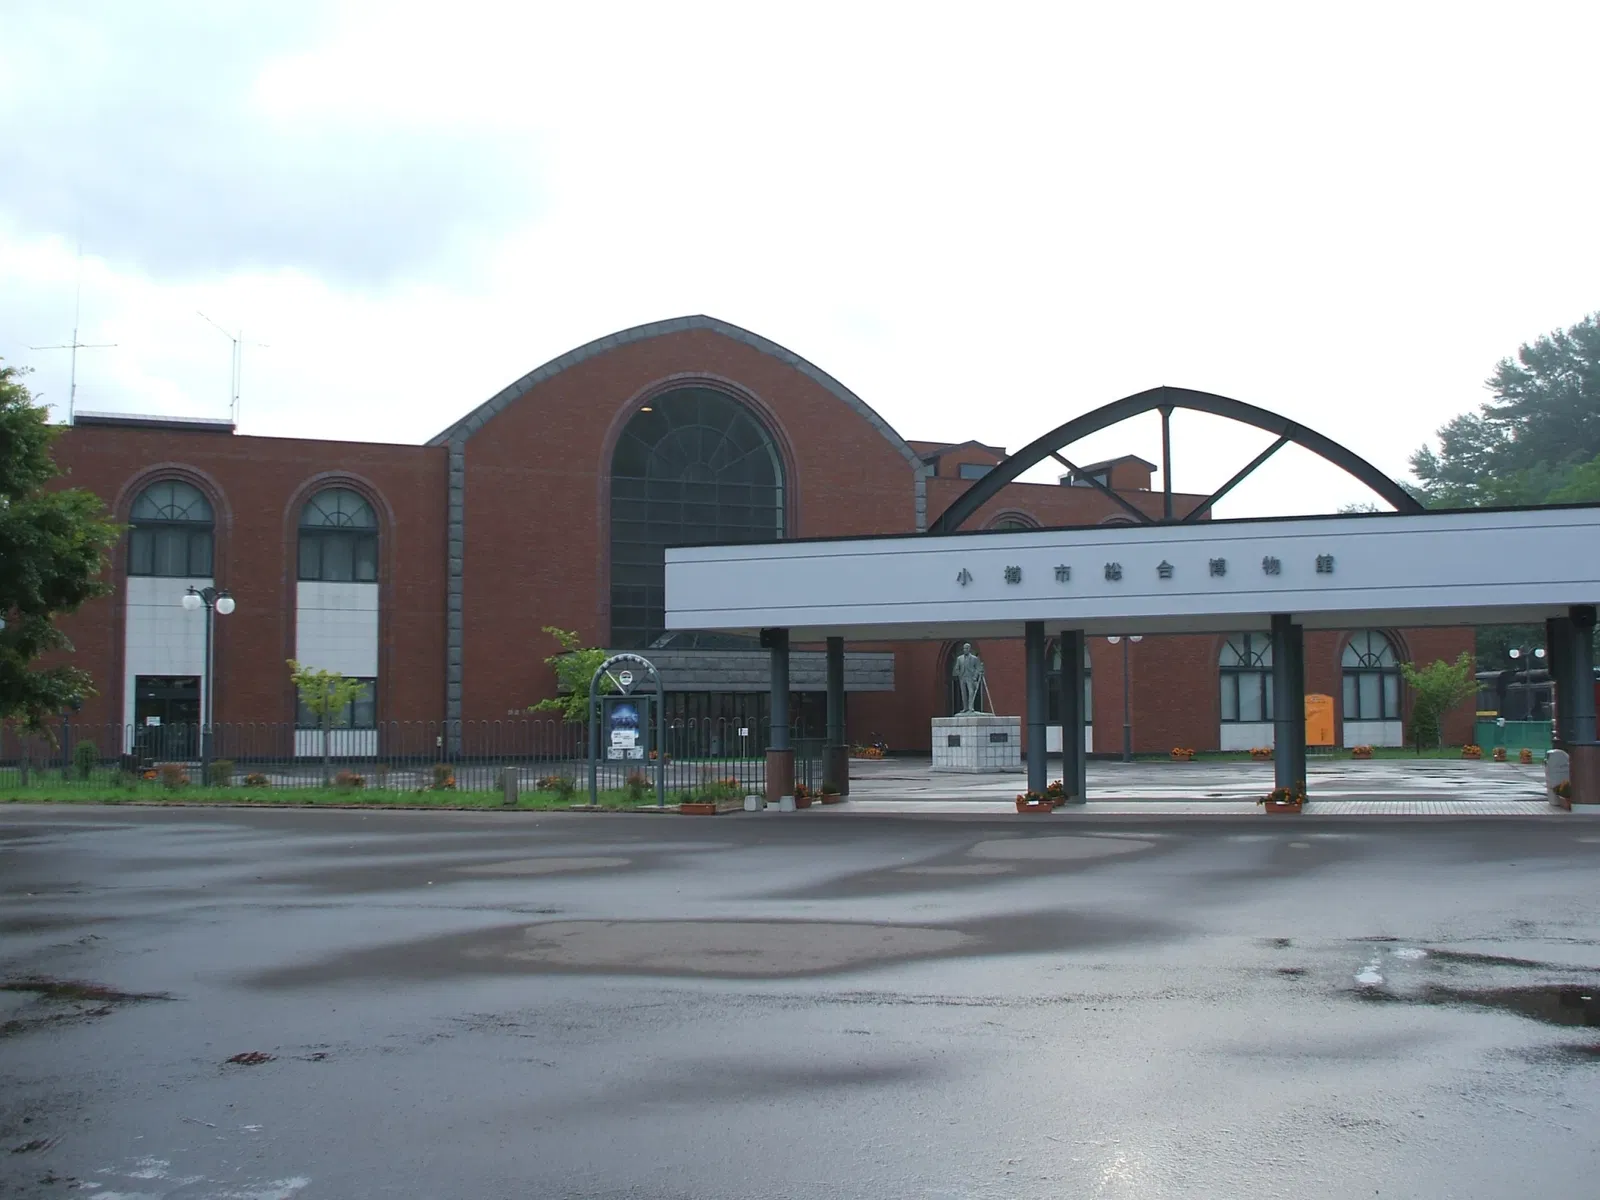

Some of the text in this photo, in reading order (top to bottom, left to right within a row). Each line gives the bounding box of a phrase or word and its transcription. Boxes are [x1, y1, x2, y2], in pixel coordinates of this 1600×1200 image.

[956, 554, 1334, 587] 小樽市総合博物館
